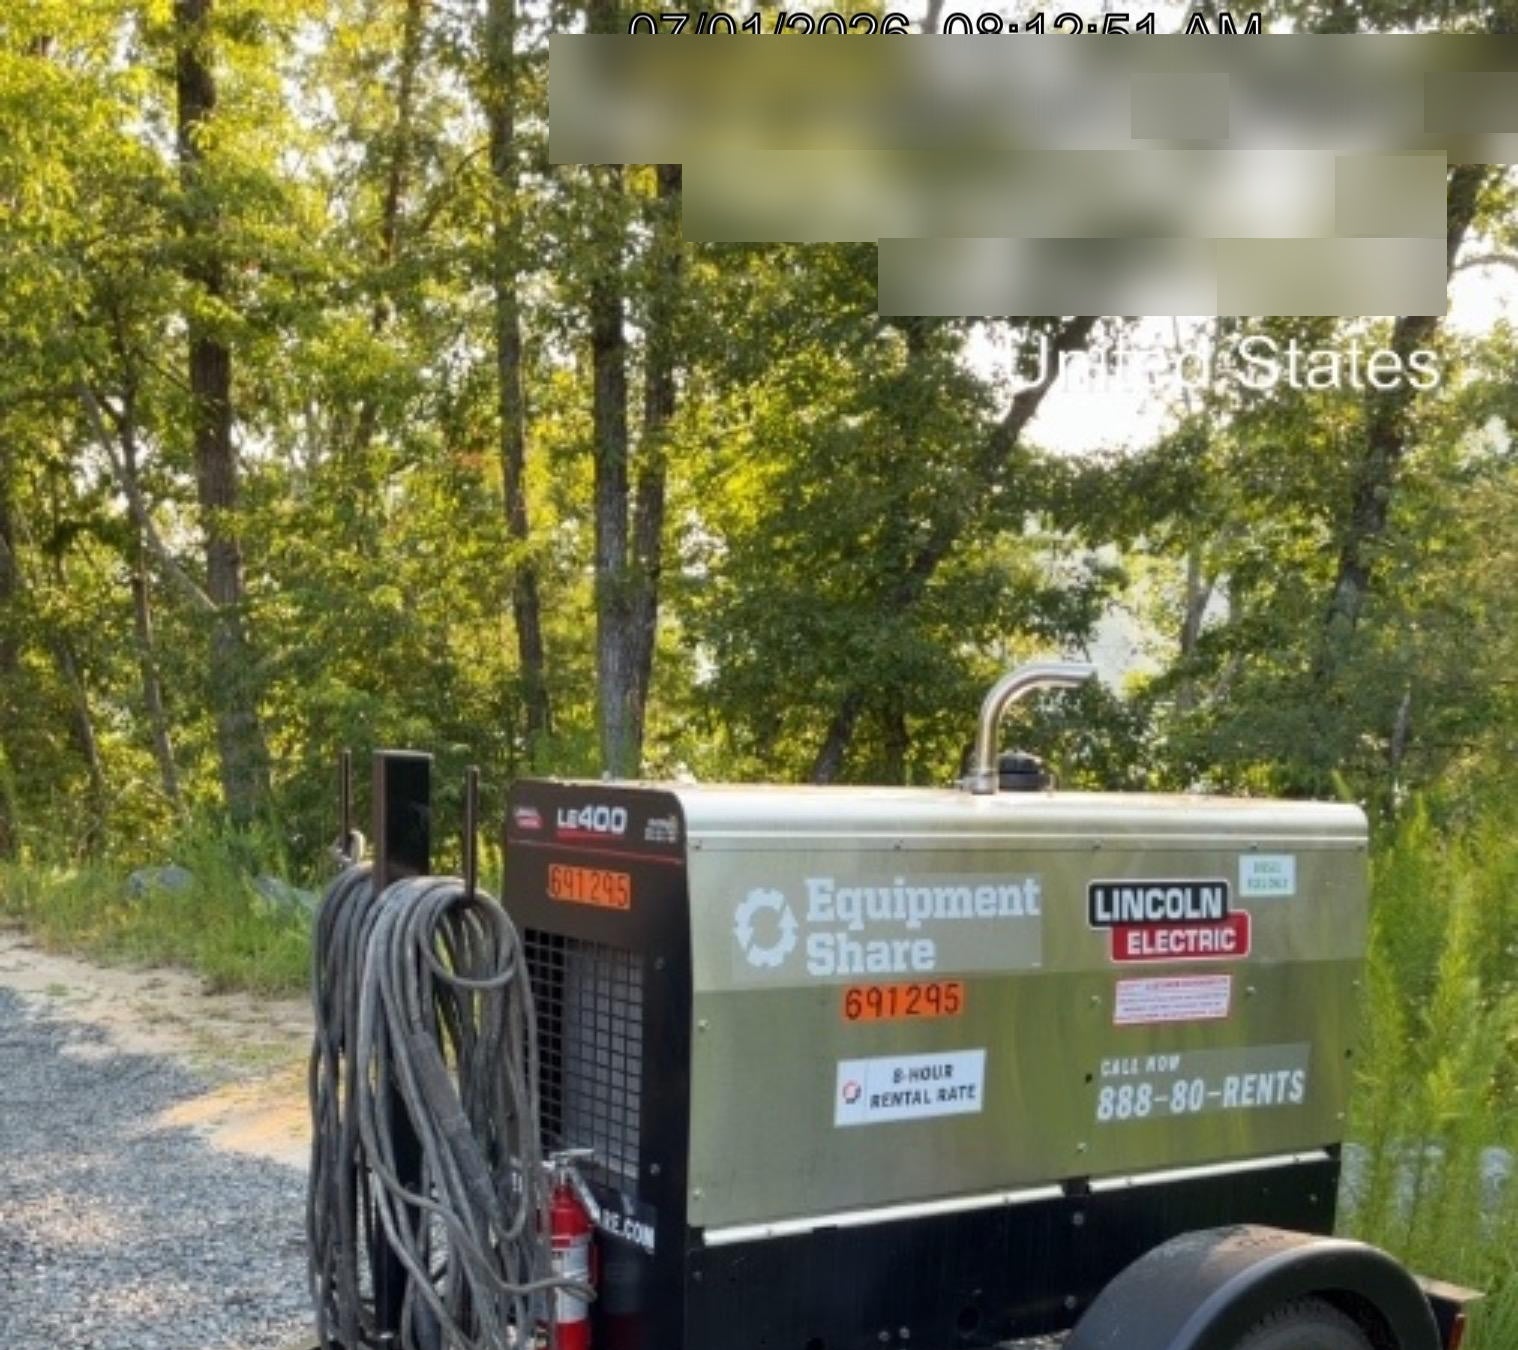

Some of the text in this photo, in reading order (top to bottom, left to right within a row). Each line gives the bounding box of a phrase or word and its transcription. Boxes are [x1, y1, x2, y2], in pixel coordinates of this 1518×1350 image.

[557, 804, 628, 835] LE400
[551, 867, 630, 906] 691295
[805, 876, 1042, 930] Equipment
[1094, 887, 1223, 922] LINCOLN
[806, 932, 936, 976] Share
[1126, 927, 1237, 956] ELECTRIC
[845, 983, 961, 1020] 691295
[1101, 1055, 1181, 1076] CALL NOW
[870, 1083, 977, 1109] RENTAL RATE
[1097, 1070, 1306, 1121] 888-80-RENTS
[600, 1208, 656, 1250] RE.COM
